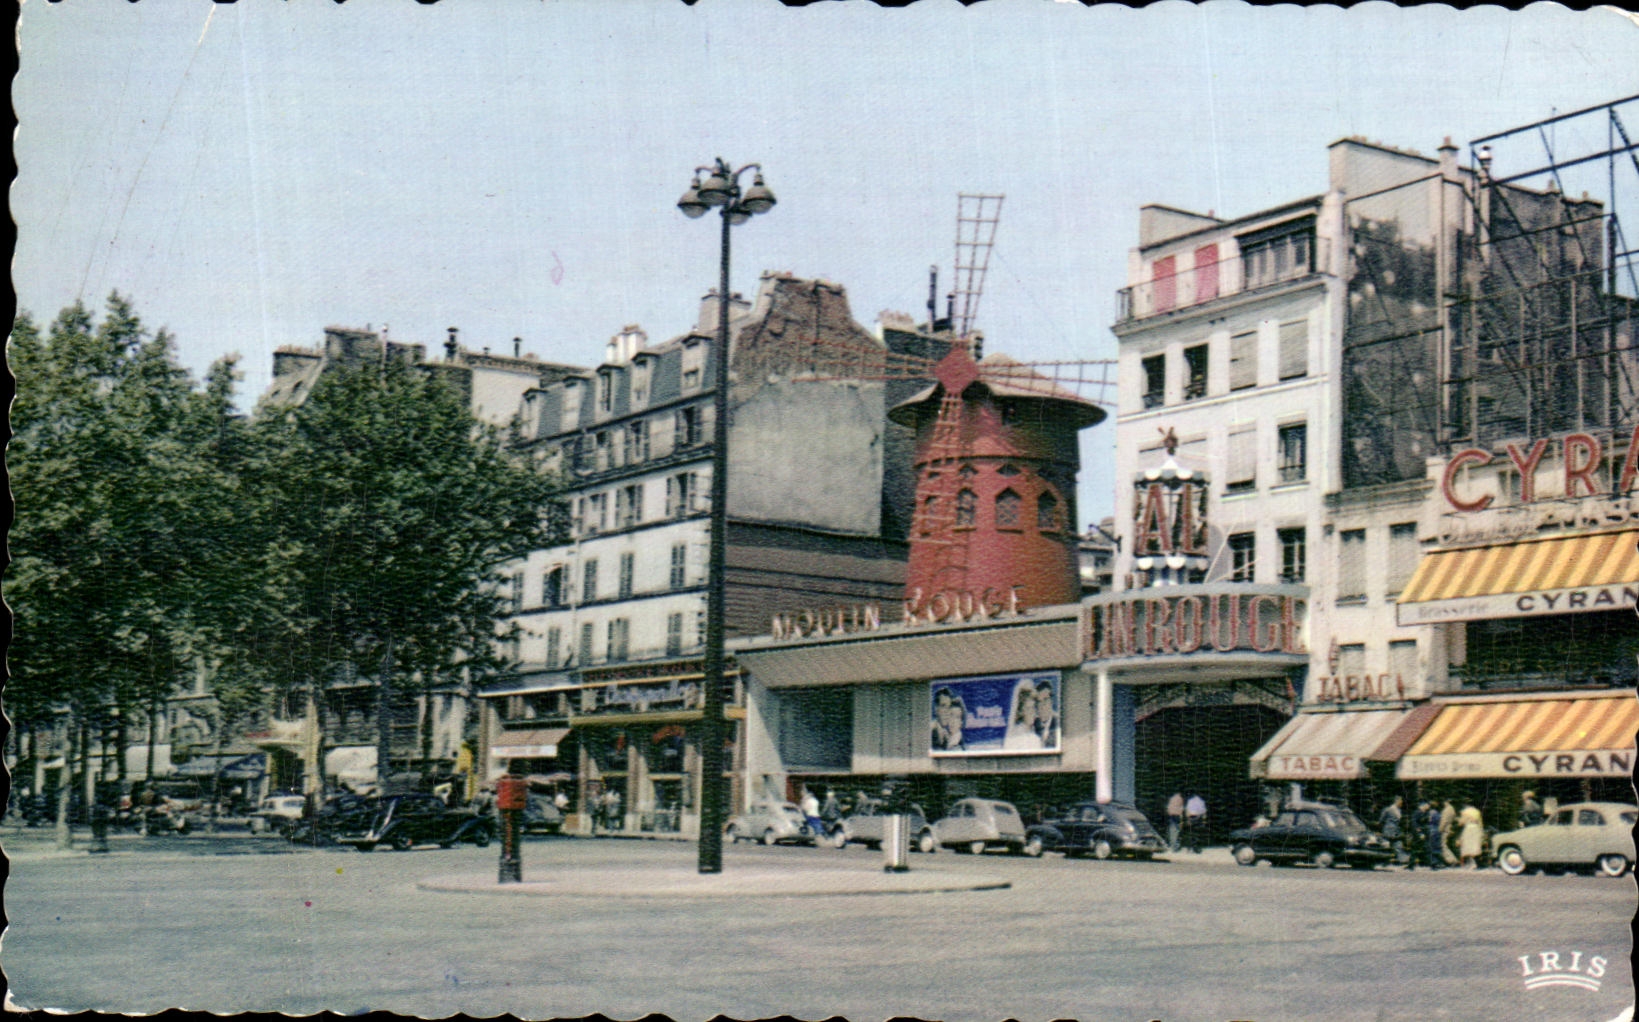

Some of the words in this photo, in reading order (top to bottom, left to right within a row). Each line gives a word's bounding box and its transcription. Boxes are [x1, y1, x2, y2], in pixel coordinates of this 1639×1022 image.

[772, 601, 880, 640] MOULIN
[903, 584, 1025, 627] ROUGE
[1317, 673, 1391, 703] TABAC
[1281, 756, 1355, 771] TABAC
[1503, 753, 1630, 773] CYRAN
